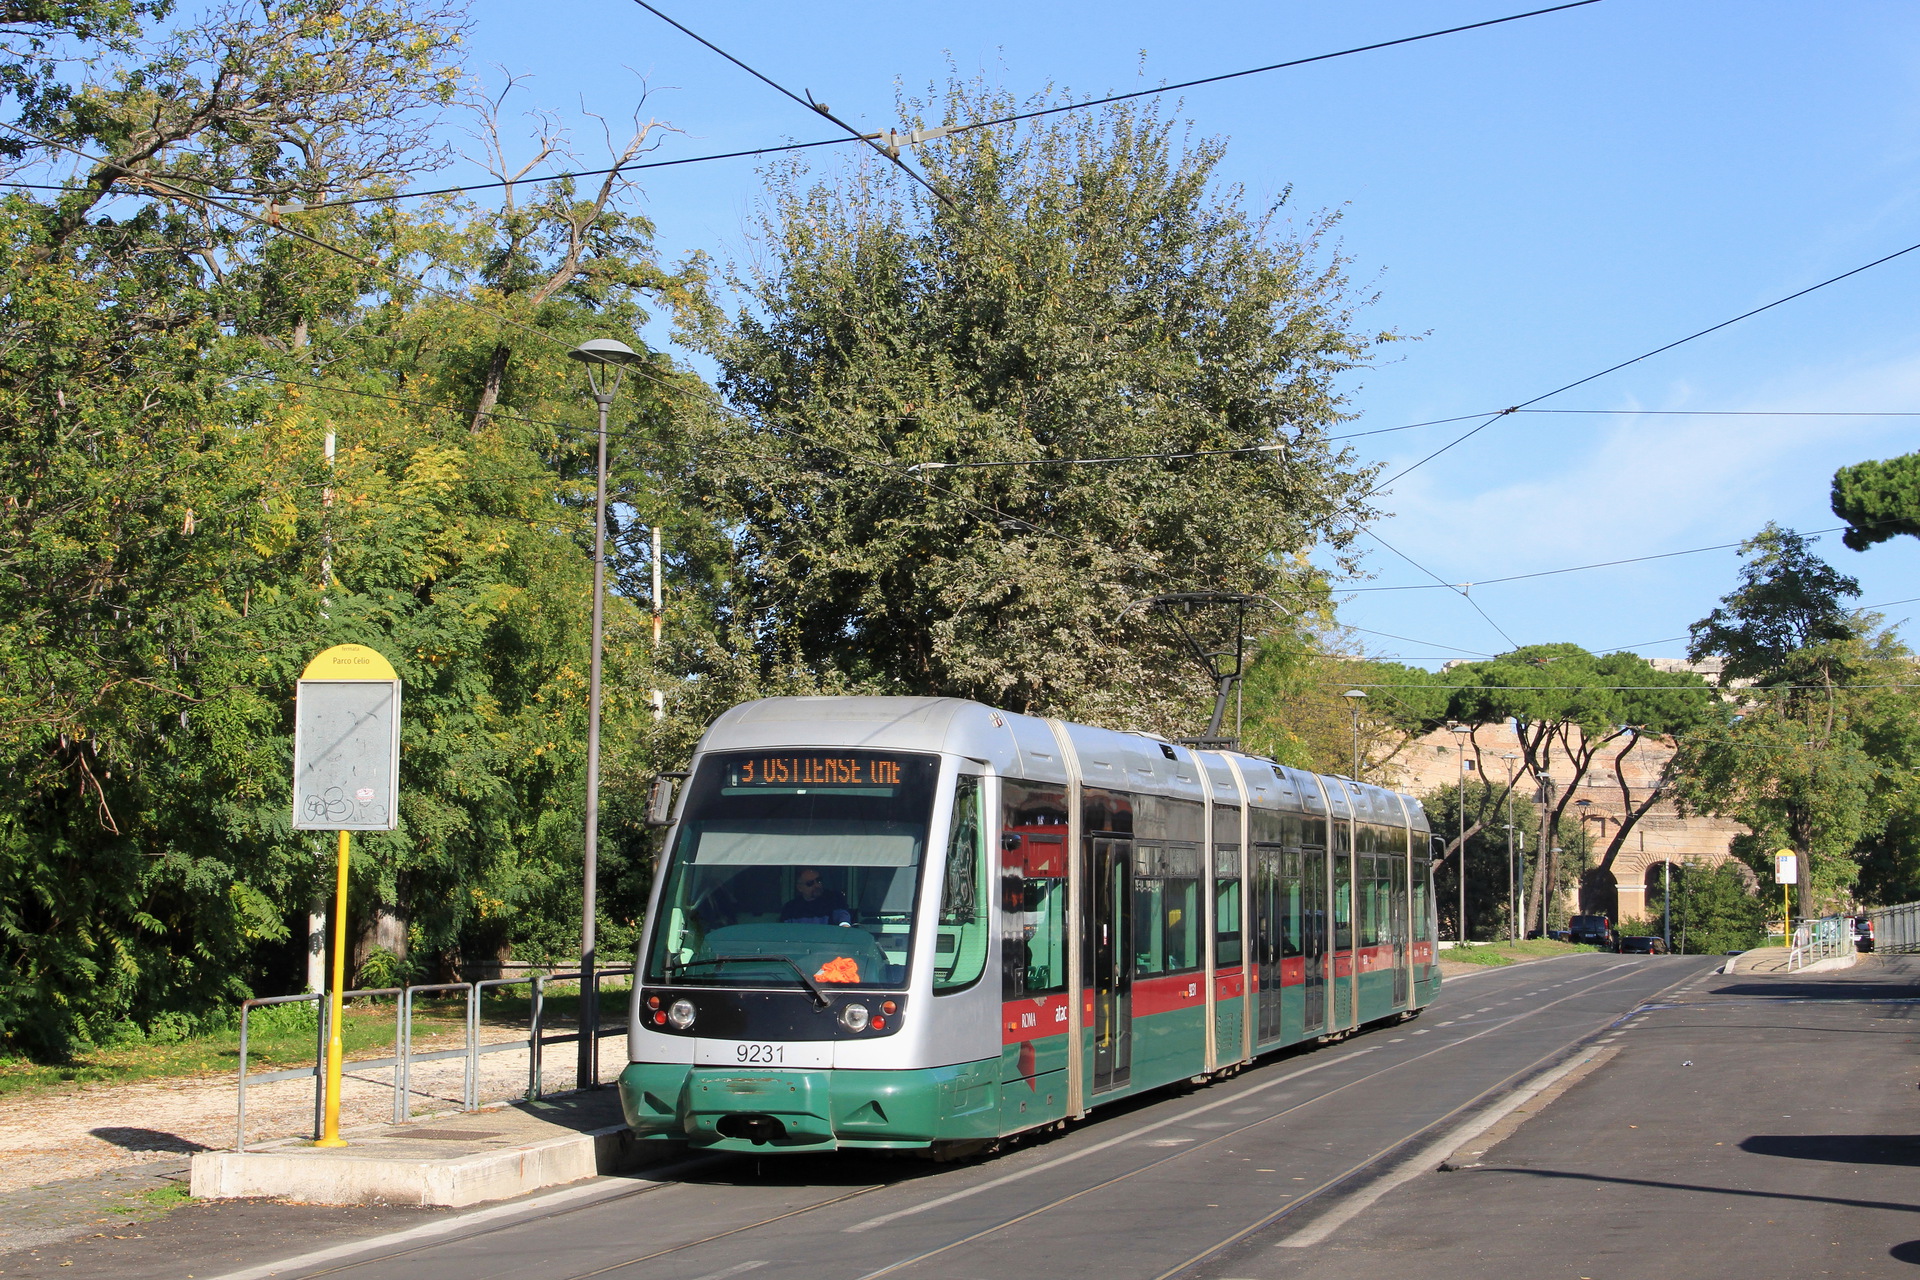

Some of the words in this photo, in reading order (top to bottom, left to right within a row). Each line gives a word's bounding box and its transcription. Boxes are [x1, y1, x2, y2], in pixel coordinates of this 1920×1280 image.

[332, 657, 352, 665] Parco
[353, 656, 370, 665] Celio
[741, 759, 754, 783] 3
[1021, 1012, 1037, 1028] ROMA
[1055, 1005, 1068, 1022] atac
[736, 1044, 784, 1063] 9231
